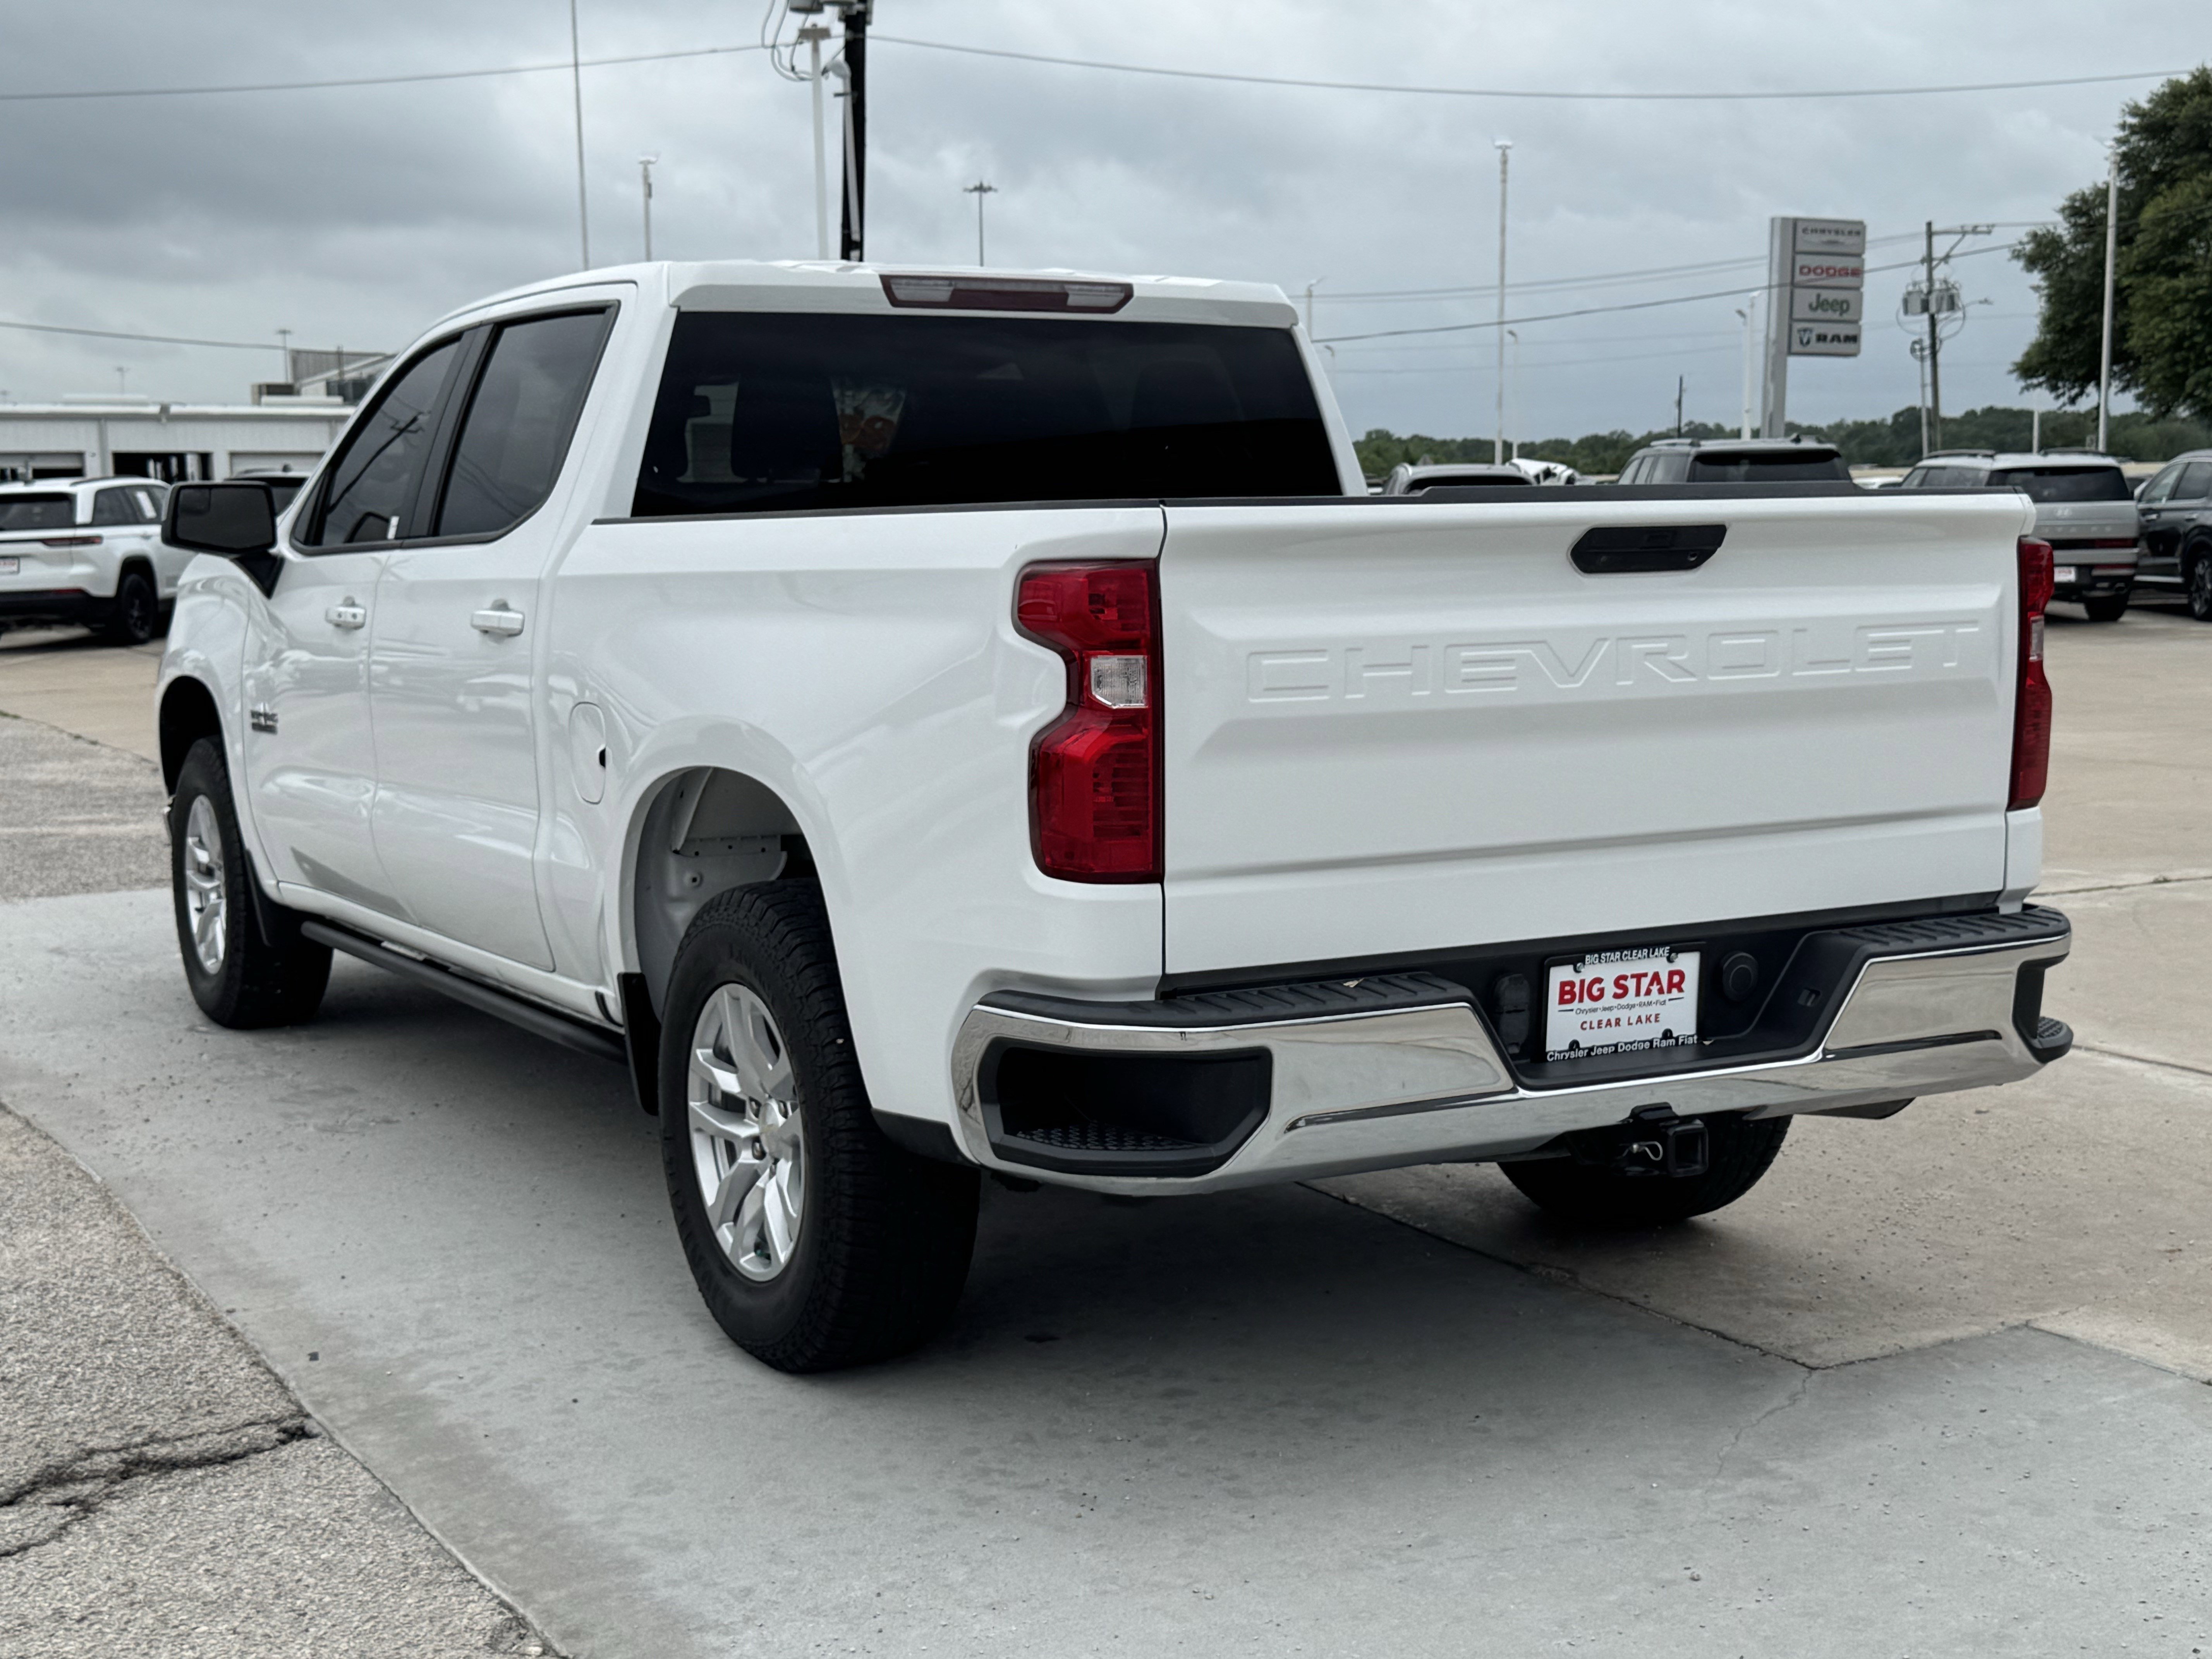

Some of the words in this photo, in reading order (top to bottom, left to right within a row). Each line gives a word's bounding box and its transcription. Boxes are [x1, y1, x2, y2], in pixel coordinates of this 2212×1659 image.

[1799, 265, 1862, 278] DODGE
[1808, 293, 1850, 316] Jeep
[1816, 334, 1857, 343] RAM
[1246, 620, 1980, 702] CHEVROLET
[1585, 954, 1599, 965] BIG
[1601, 951, 1620, 962] STAR
[1622, 948, 1647, 960] CLEAR
[1649, 946, 1670, 957] LAKE
[1558, 977, 1605, 1005] BIG
[1612, 969, 1685, 999] STAR
[1580, 1017, 1621, 1031] CLEAR
[1627, 1013, 1661, 1026] LAKE
[1547, 1048, 1588, 1062] Chrysler
[1590, 1045, 1615, 1056] Jeep
[1618, 1041, 1650, 1052] Dodge
[1653, 1037, 1675, 1047] Ram
[1678, 1034, 1697, 1045] Fiat
